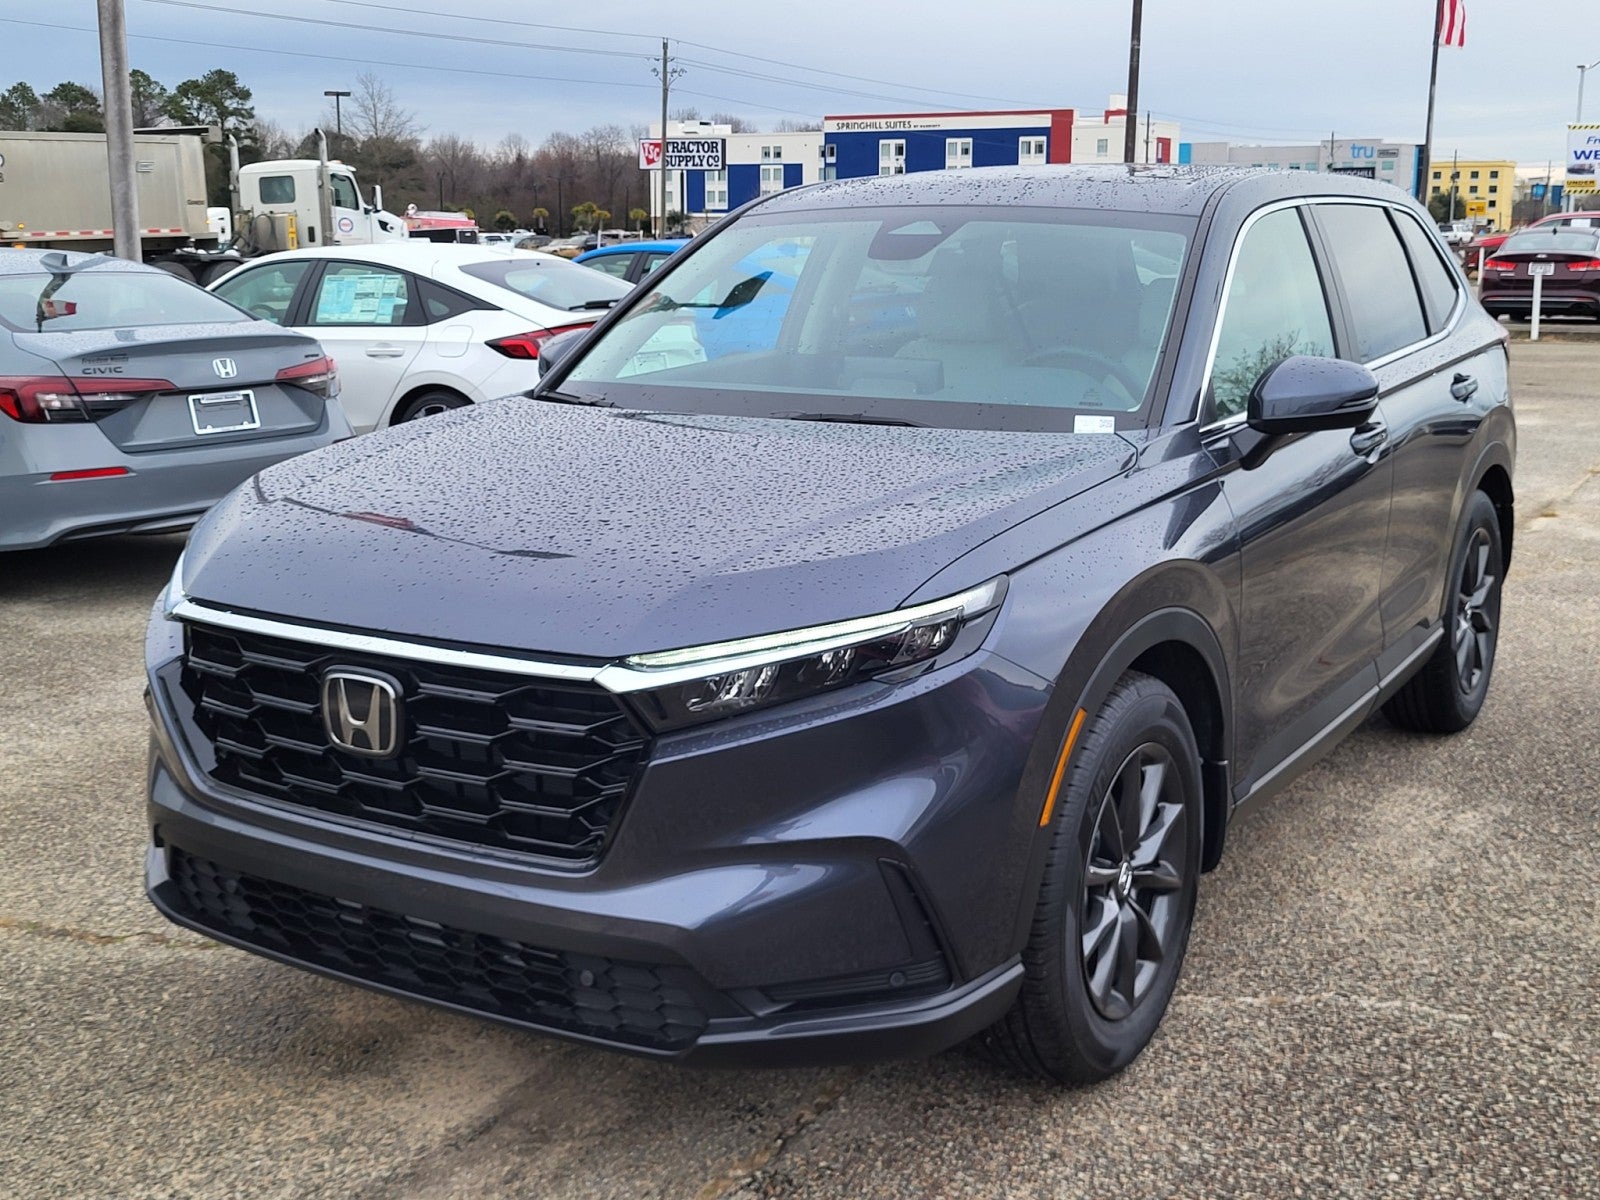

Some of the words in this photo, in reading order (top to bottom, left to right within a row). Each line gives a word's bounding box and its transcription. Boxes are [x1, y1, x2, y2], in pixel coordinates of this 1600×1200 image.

[836, 121, 882, 130] SPRINGHILL
[884, 120, 912, 129] SUITES
[643, 143, 660, 162] TSC
[666, 141, 719, 153] TRACTOR
[1350, 143, 1374, 158] tru
[665, 155, 705, 167] SUPPLY
[81, 366, 123, 375] CIVIC
